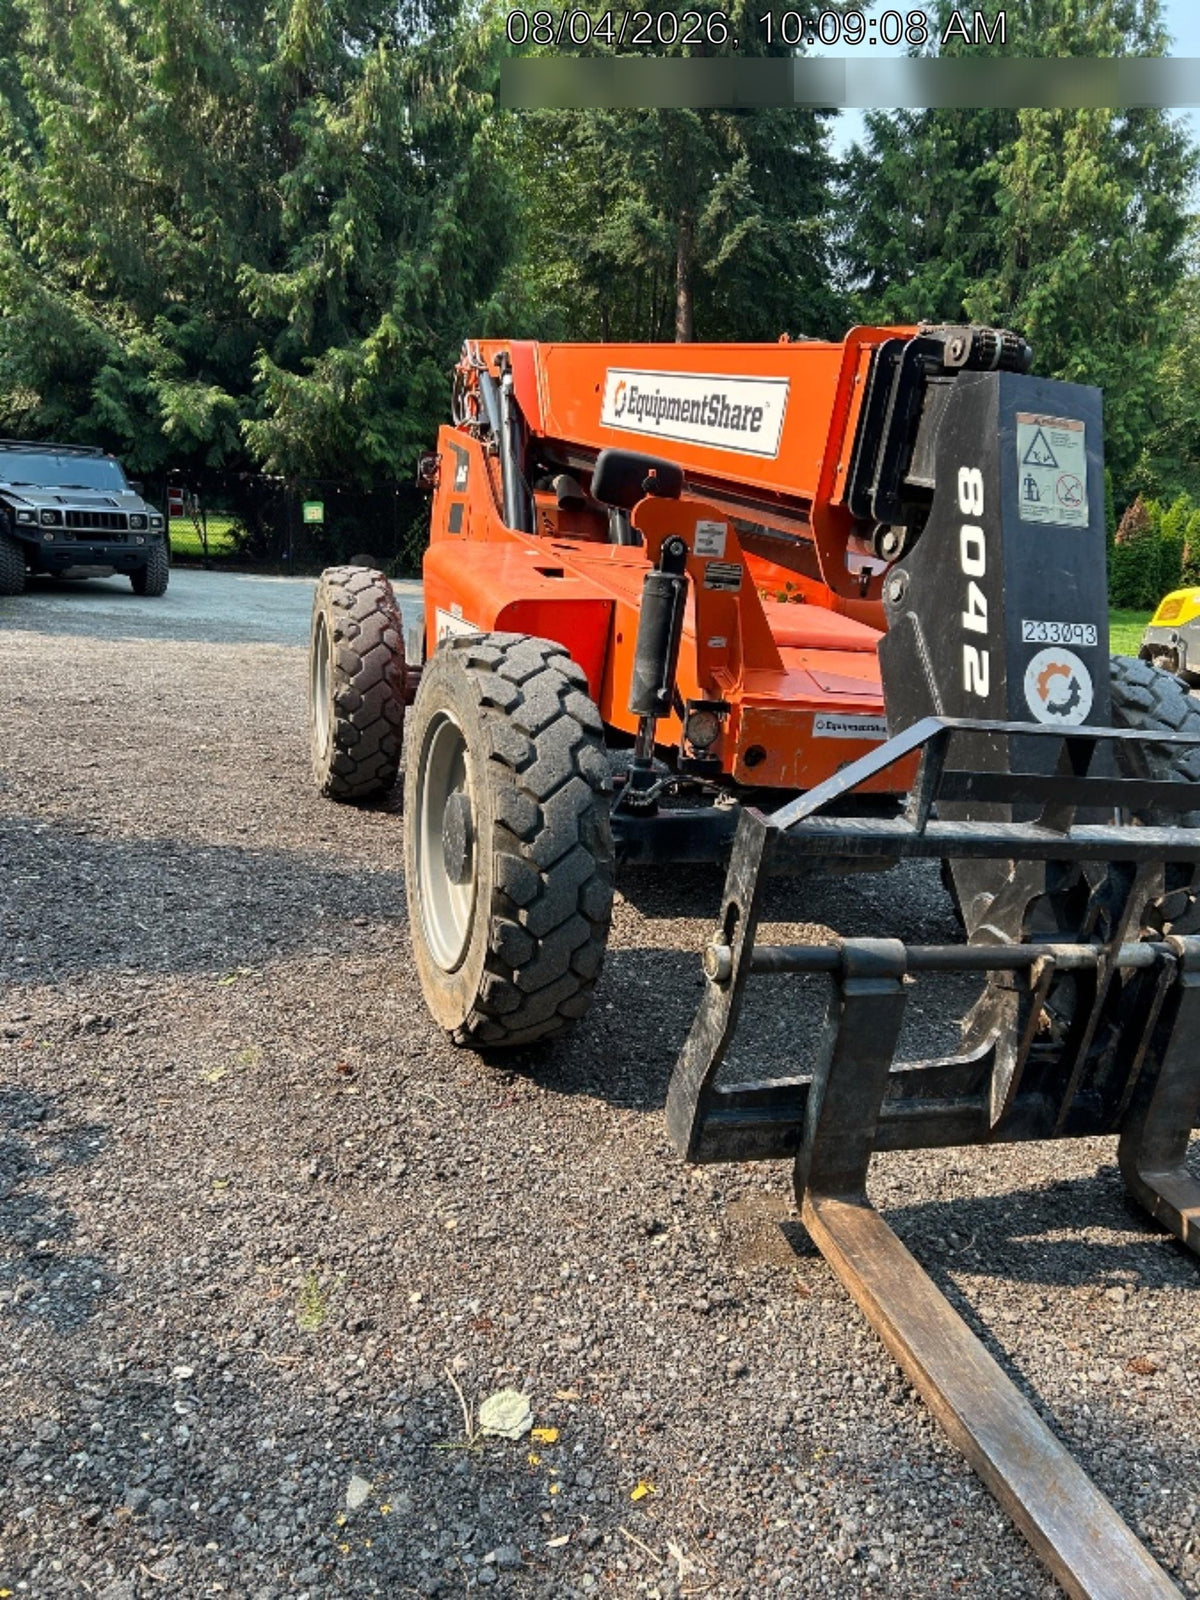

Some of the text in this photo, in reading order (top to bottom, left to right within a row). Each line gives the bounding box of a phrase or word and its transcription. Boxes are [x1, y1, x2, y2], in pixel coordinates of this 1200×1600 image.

[627, 386, 763, 432] EquipmentShare
[957, 466, 989, 698] 8042
[1024, 622, 1096, 644] 233093
